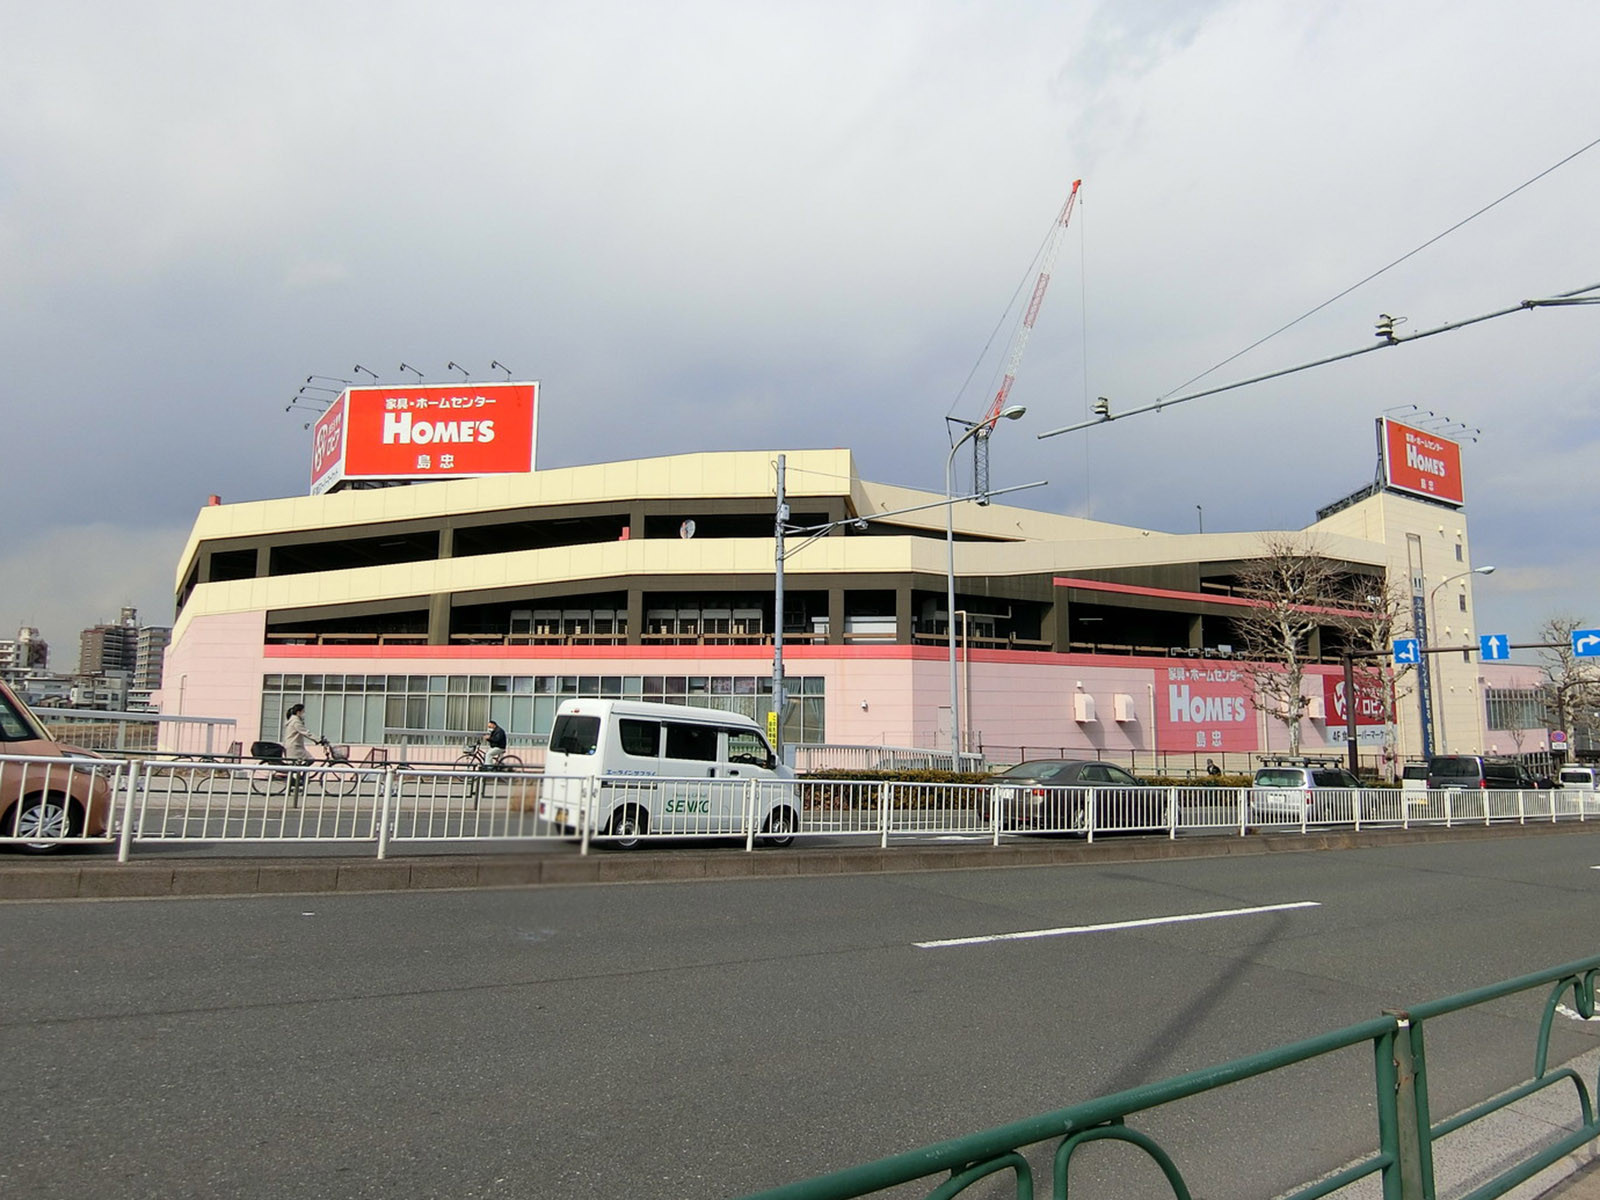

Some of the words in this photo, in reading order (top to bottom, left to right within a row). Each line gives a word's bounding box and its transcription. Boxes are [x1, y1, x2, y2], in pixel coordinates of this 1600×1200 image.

[385, 396, 497, 410] 家具・ホームセンター
[382, 411, 496, 445] HOME'S
[1406, 443, 1446, 477] HOME'S
[1168, 667, 1244, 683] 家具・ホームセンター
[1168, 684, 1246, 724] HOME'S
